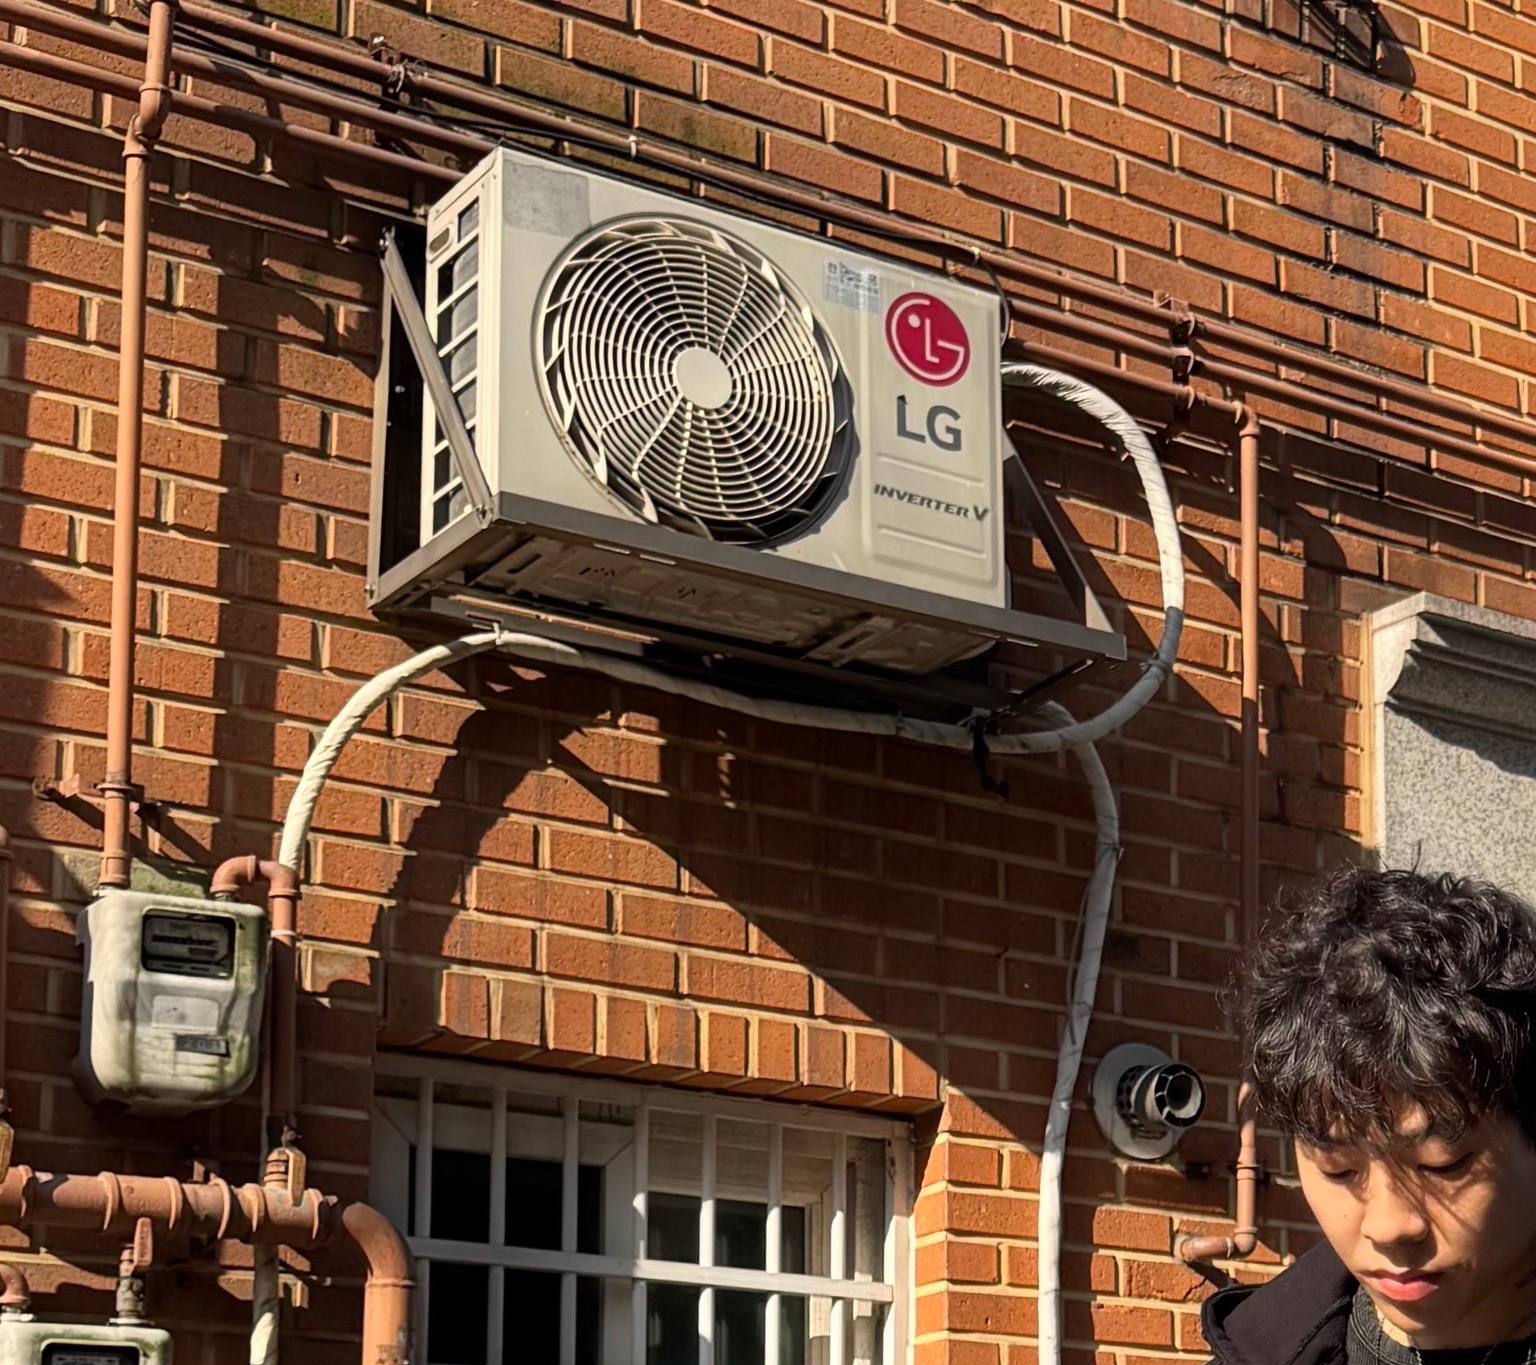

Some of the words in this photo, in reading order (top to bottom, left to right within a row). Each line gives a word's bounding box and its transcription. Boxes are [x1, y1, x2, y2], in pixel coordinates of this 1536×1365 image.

[896, 394, 963, 452] LG
[873, 484, 969, 519] INVERTER
[973, 505, 989, 522] V
